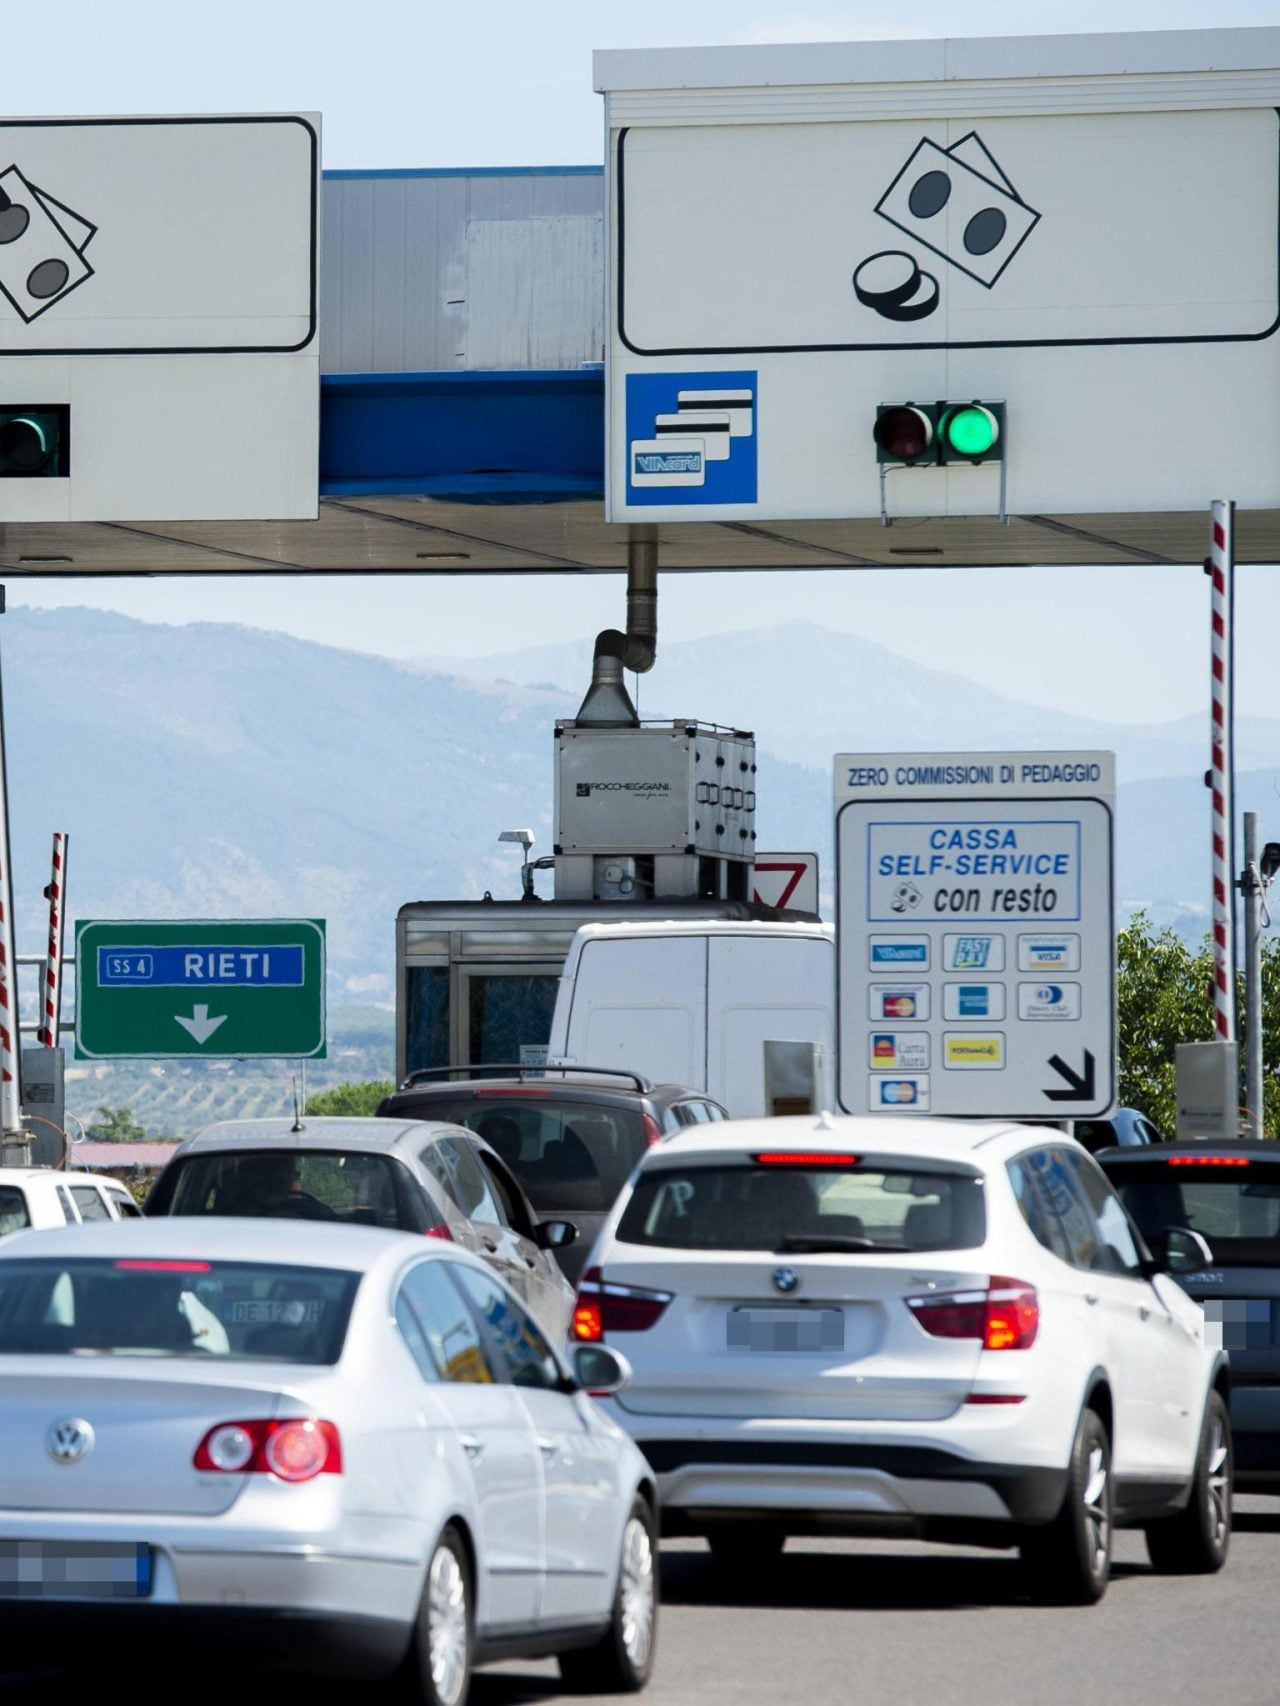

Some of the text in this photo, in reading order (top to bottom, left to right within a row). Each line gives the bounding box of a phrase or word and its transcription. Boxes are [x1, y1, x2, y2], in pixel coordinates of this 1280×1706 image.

[636, 455, 701, 472] VIAcard
[848, 763, 1101, 787] ZERO COMMISSIONI DI PEDAGGIO
[929, 829, 1018, 850] CASSA
[878, 854, 1069, 876] SELF-SERVICE
[933, 883, 1058, 912] con resto
[959, 938, 990, 951] FAST
[185, 953, 269, 978] RIETI
[1037, 952, 1062, 961] VISA
[113, 959, 146, 974] SS 4
[897, 1042, 926, 1054] Carta
